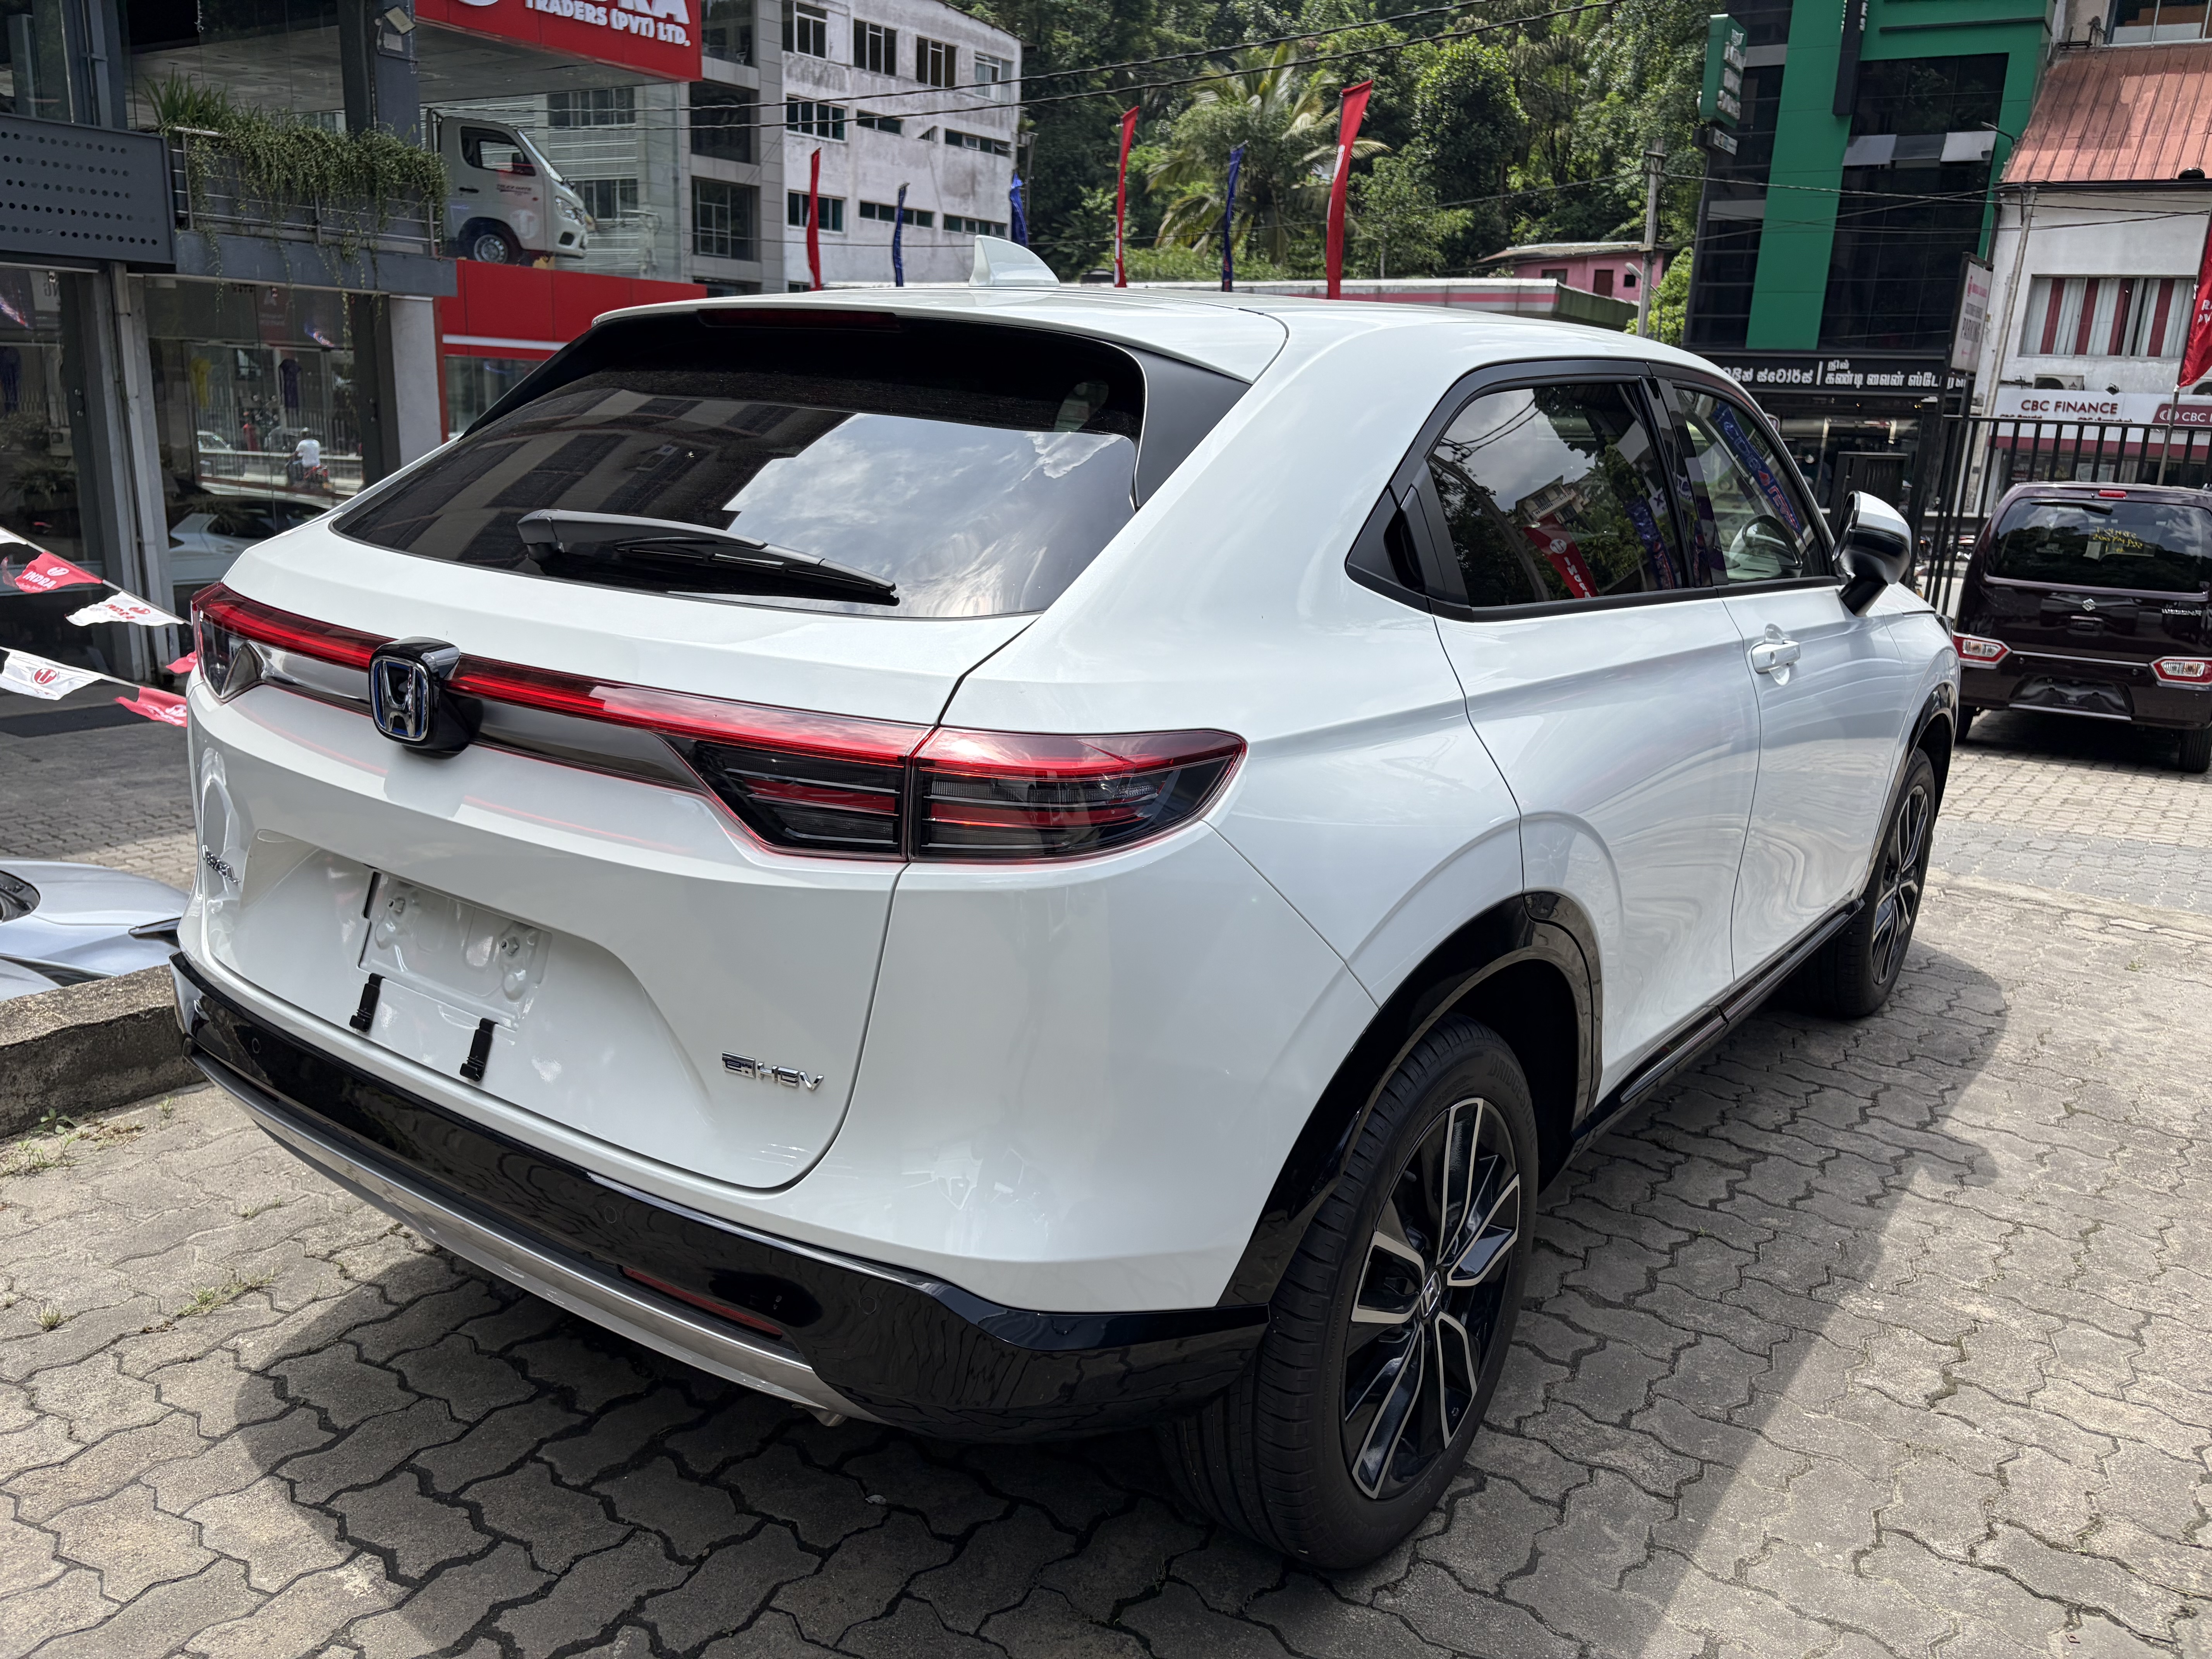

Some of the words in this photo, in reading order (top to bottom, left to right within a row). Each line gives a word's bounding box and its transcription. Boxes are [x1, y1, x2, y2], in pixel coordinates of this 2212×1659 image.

[610, 8, 655, 38] (PVT)
[656, 21, 691, 46] LTD.
[2021, 400, 2049, 411] CBC
[2054, 401, 2118, 414] FINANCE
[2181, 412, 2207, 422] CBC
[22, 570, 57, 589] INDRA
